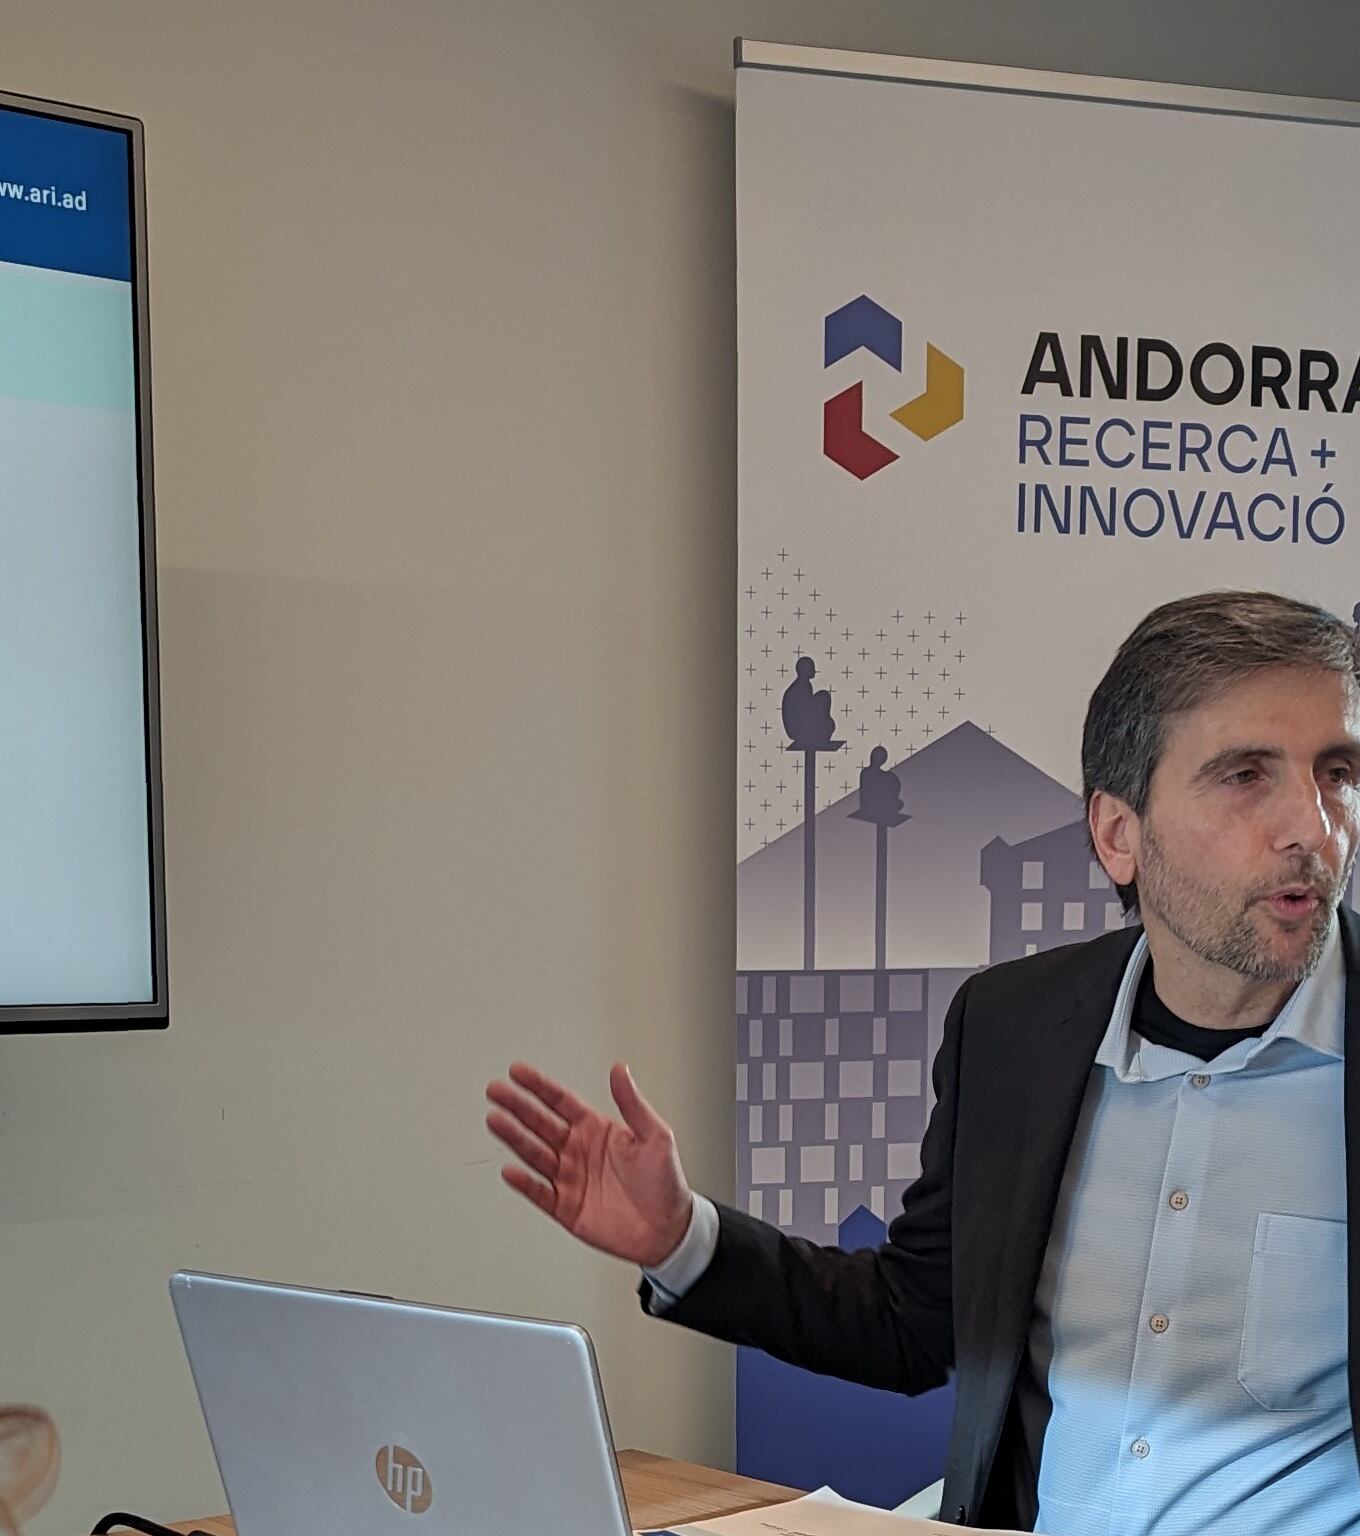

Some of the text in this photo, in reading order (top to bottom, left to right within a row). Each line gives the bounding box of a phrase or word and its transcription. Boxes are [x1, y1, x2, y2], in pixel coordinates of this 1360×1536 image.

[1019, 413, 1298, 477] RECERCA
[1017, 482, 1346, 545] INNOVACIÓ
[387, 1444, 423, 1514] hp
